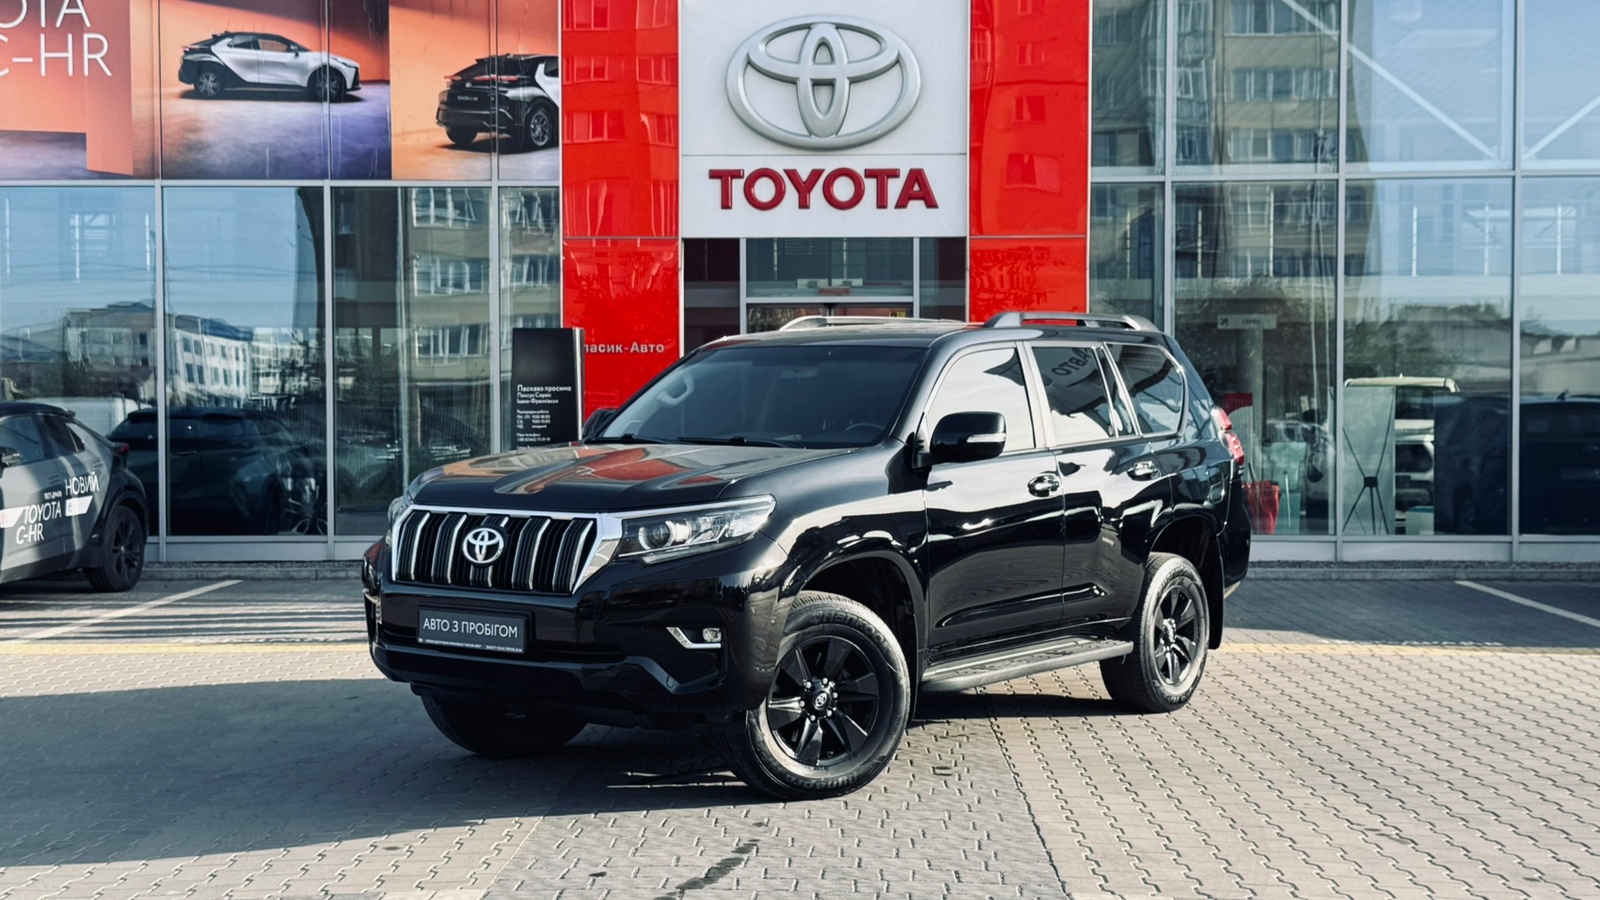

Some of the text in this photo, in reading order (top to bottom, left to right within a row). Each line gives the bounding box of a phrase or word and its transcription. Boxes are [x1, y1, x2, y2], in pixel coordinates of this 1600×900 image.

[708, 167, 939, 210] TOYOTA
[65, 472, 100, 496] НОВИЙ
[23, 500, 62, 525] TOYOTA
[16, 523, 45, 545] C-HR
[423, 618, 450, 632] АВТО
[461, 621, 518, 639] ПРОБІГОМ
